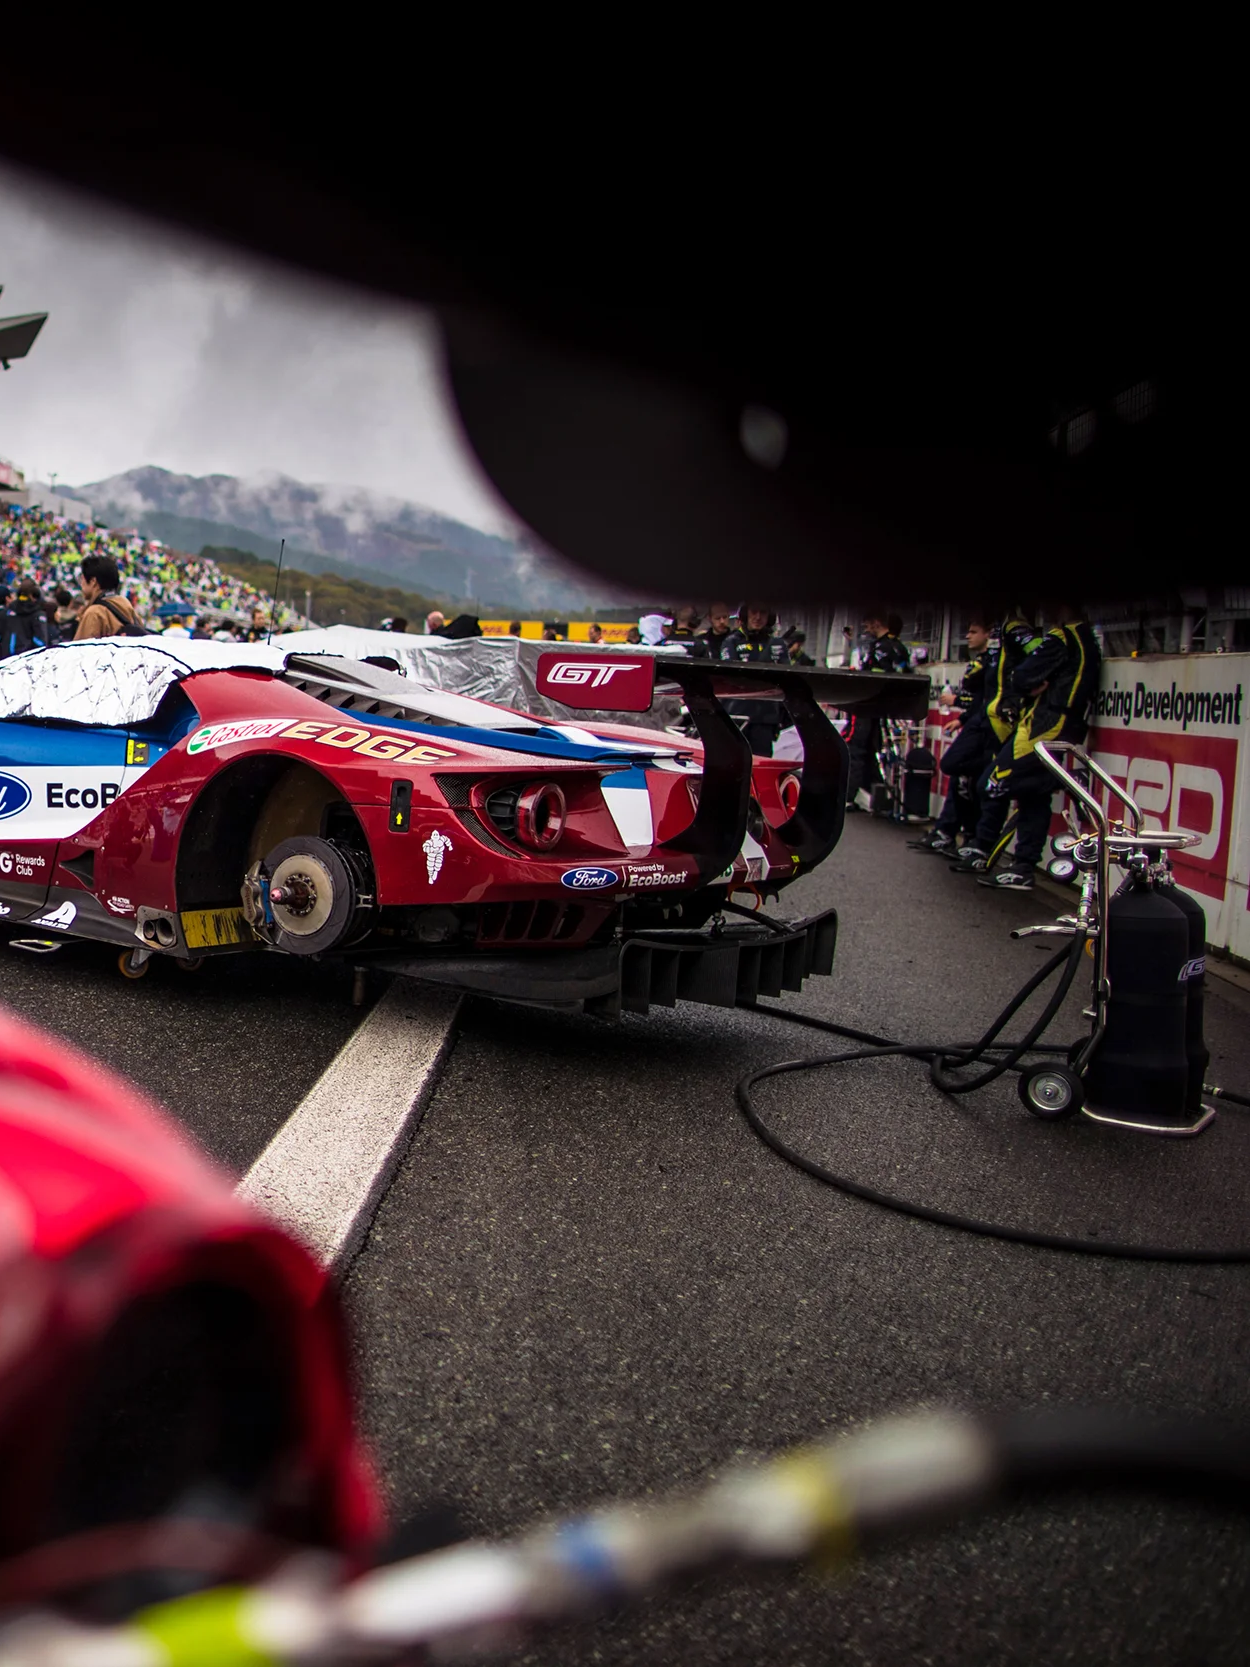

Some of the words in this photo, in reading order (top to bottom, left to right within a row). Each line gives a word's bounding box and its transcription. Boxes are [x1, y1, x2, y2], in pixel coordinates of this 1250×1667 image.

[546, 662, 642, 688] GT
[1133, 682, 1243, 731] Development
[207, 720, 280, 747] Castrol
[278, 721, 457, 766] EDGE
[15, 853, 46, 867] Rewards
[627, 864, 656, 873] Powered
[655, 863, 665, 872] by
[15, 864, 34, 877] Club
[572, 870, 608, 887] Ford
[628, 871, 687, 888] EcoBoost
